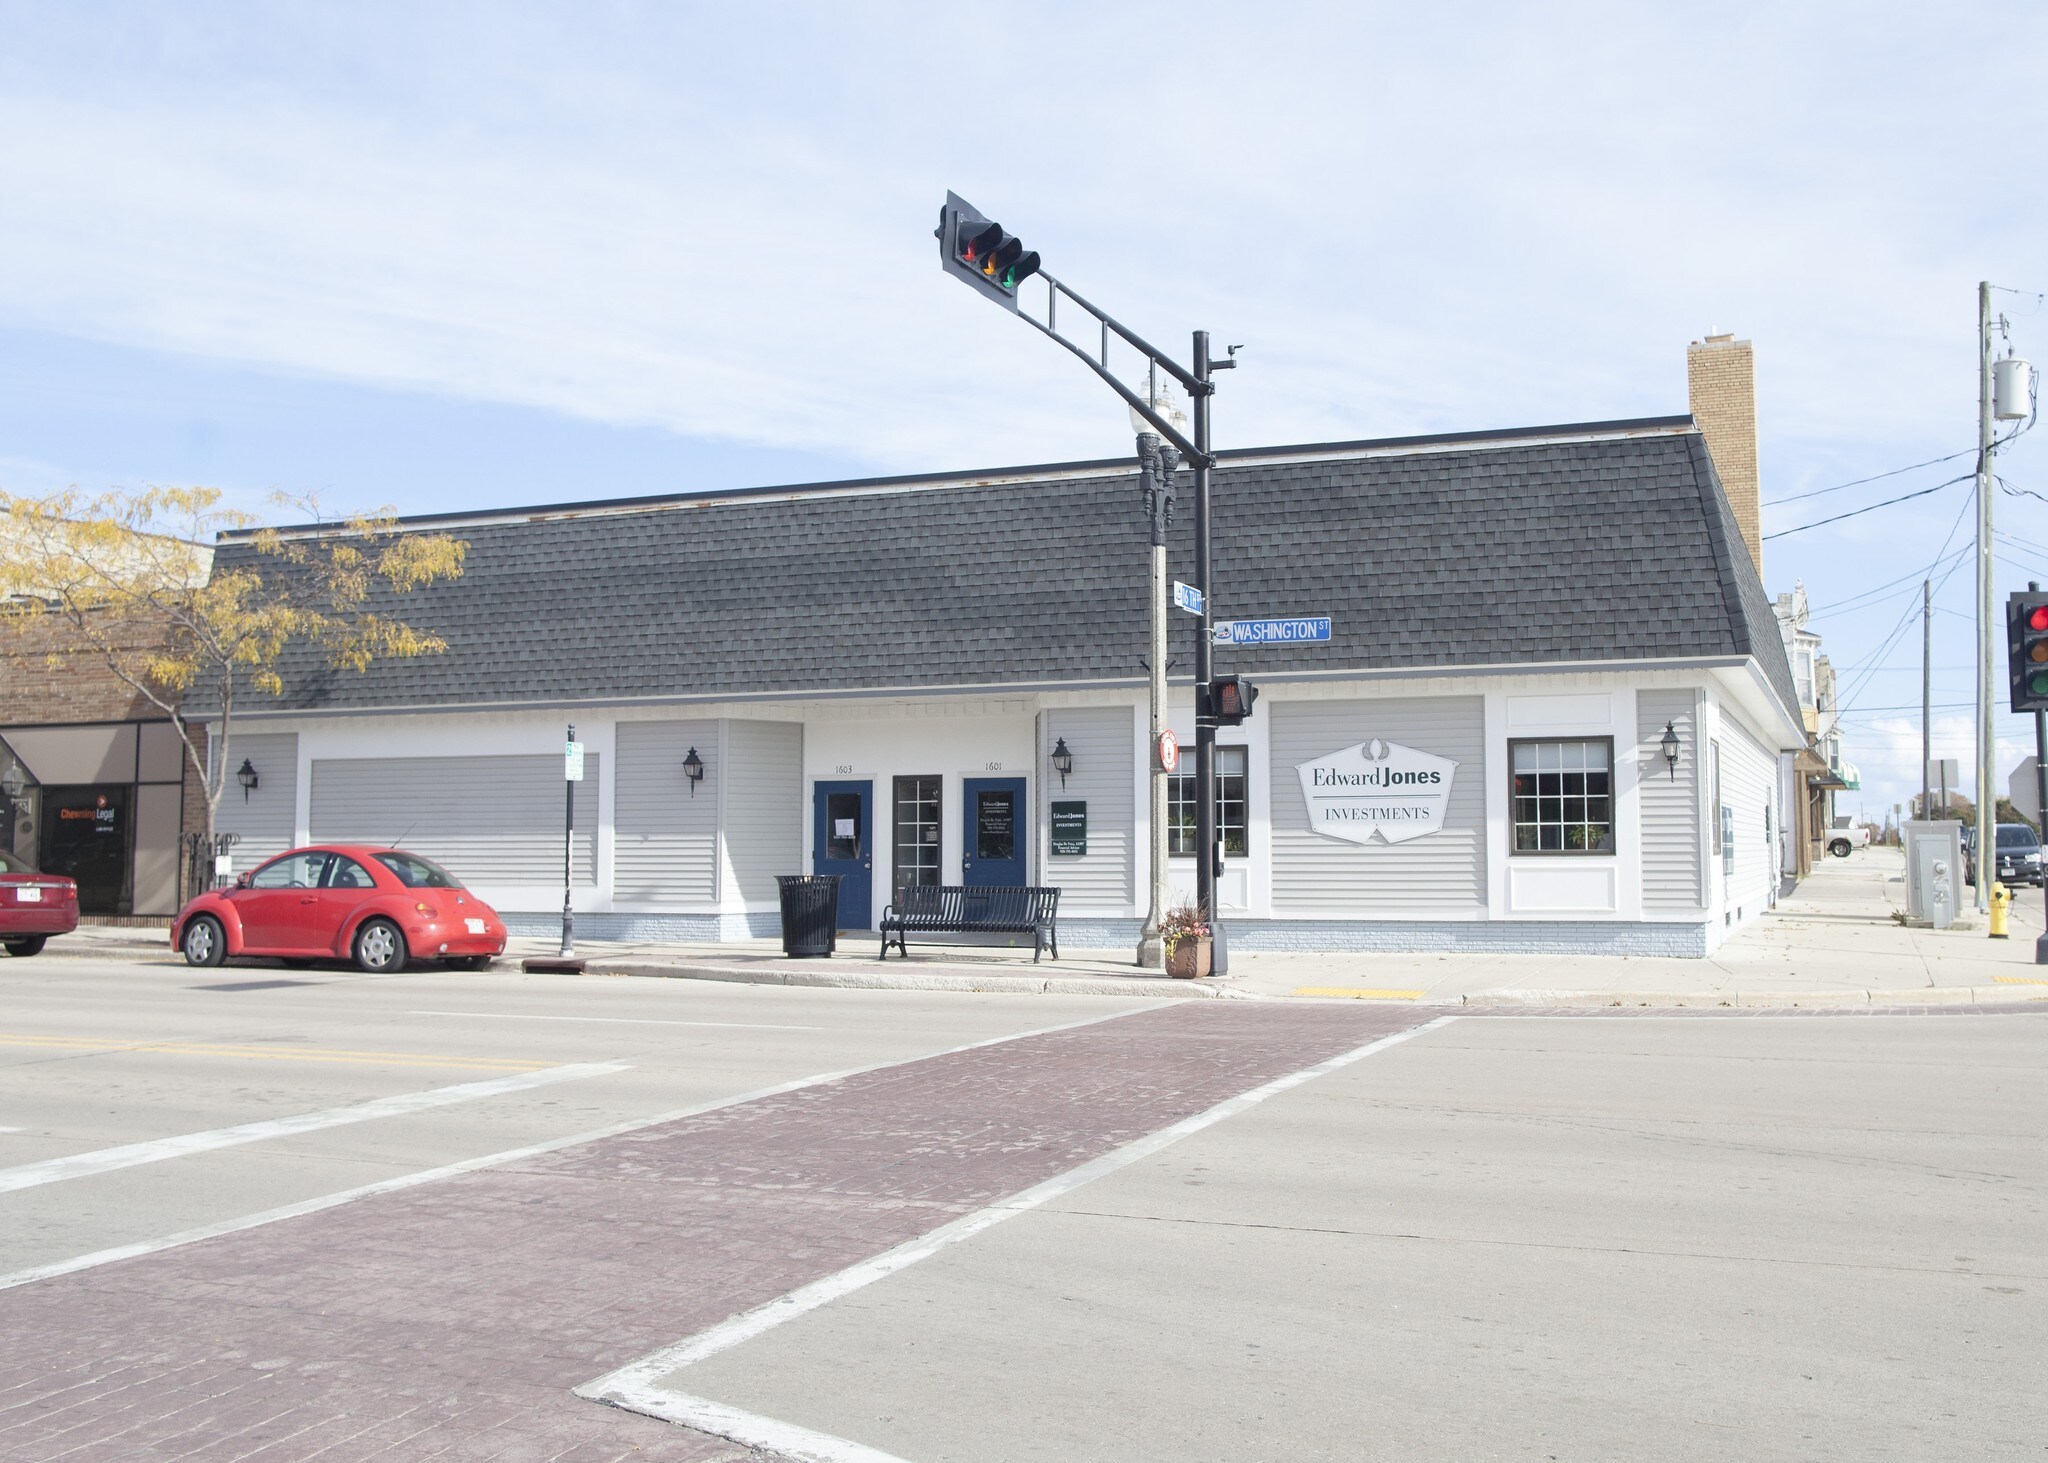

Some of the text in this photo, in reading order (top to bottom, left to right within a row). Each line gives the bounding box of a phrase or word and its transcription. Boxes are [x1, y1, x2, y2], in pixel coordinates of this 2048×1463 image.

[1234, 620, 1329, 641] WASHINGTON ST
[835, 766, 852, 774] 1603
[985, 762, 1002, 771] 1601
[1312, 767, 1441, 787] Edward Jones
[60, 808, 115, 821] Chewning Legal
[1325, 807, 1430, 821] INVESTMENTS
